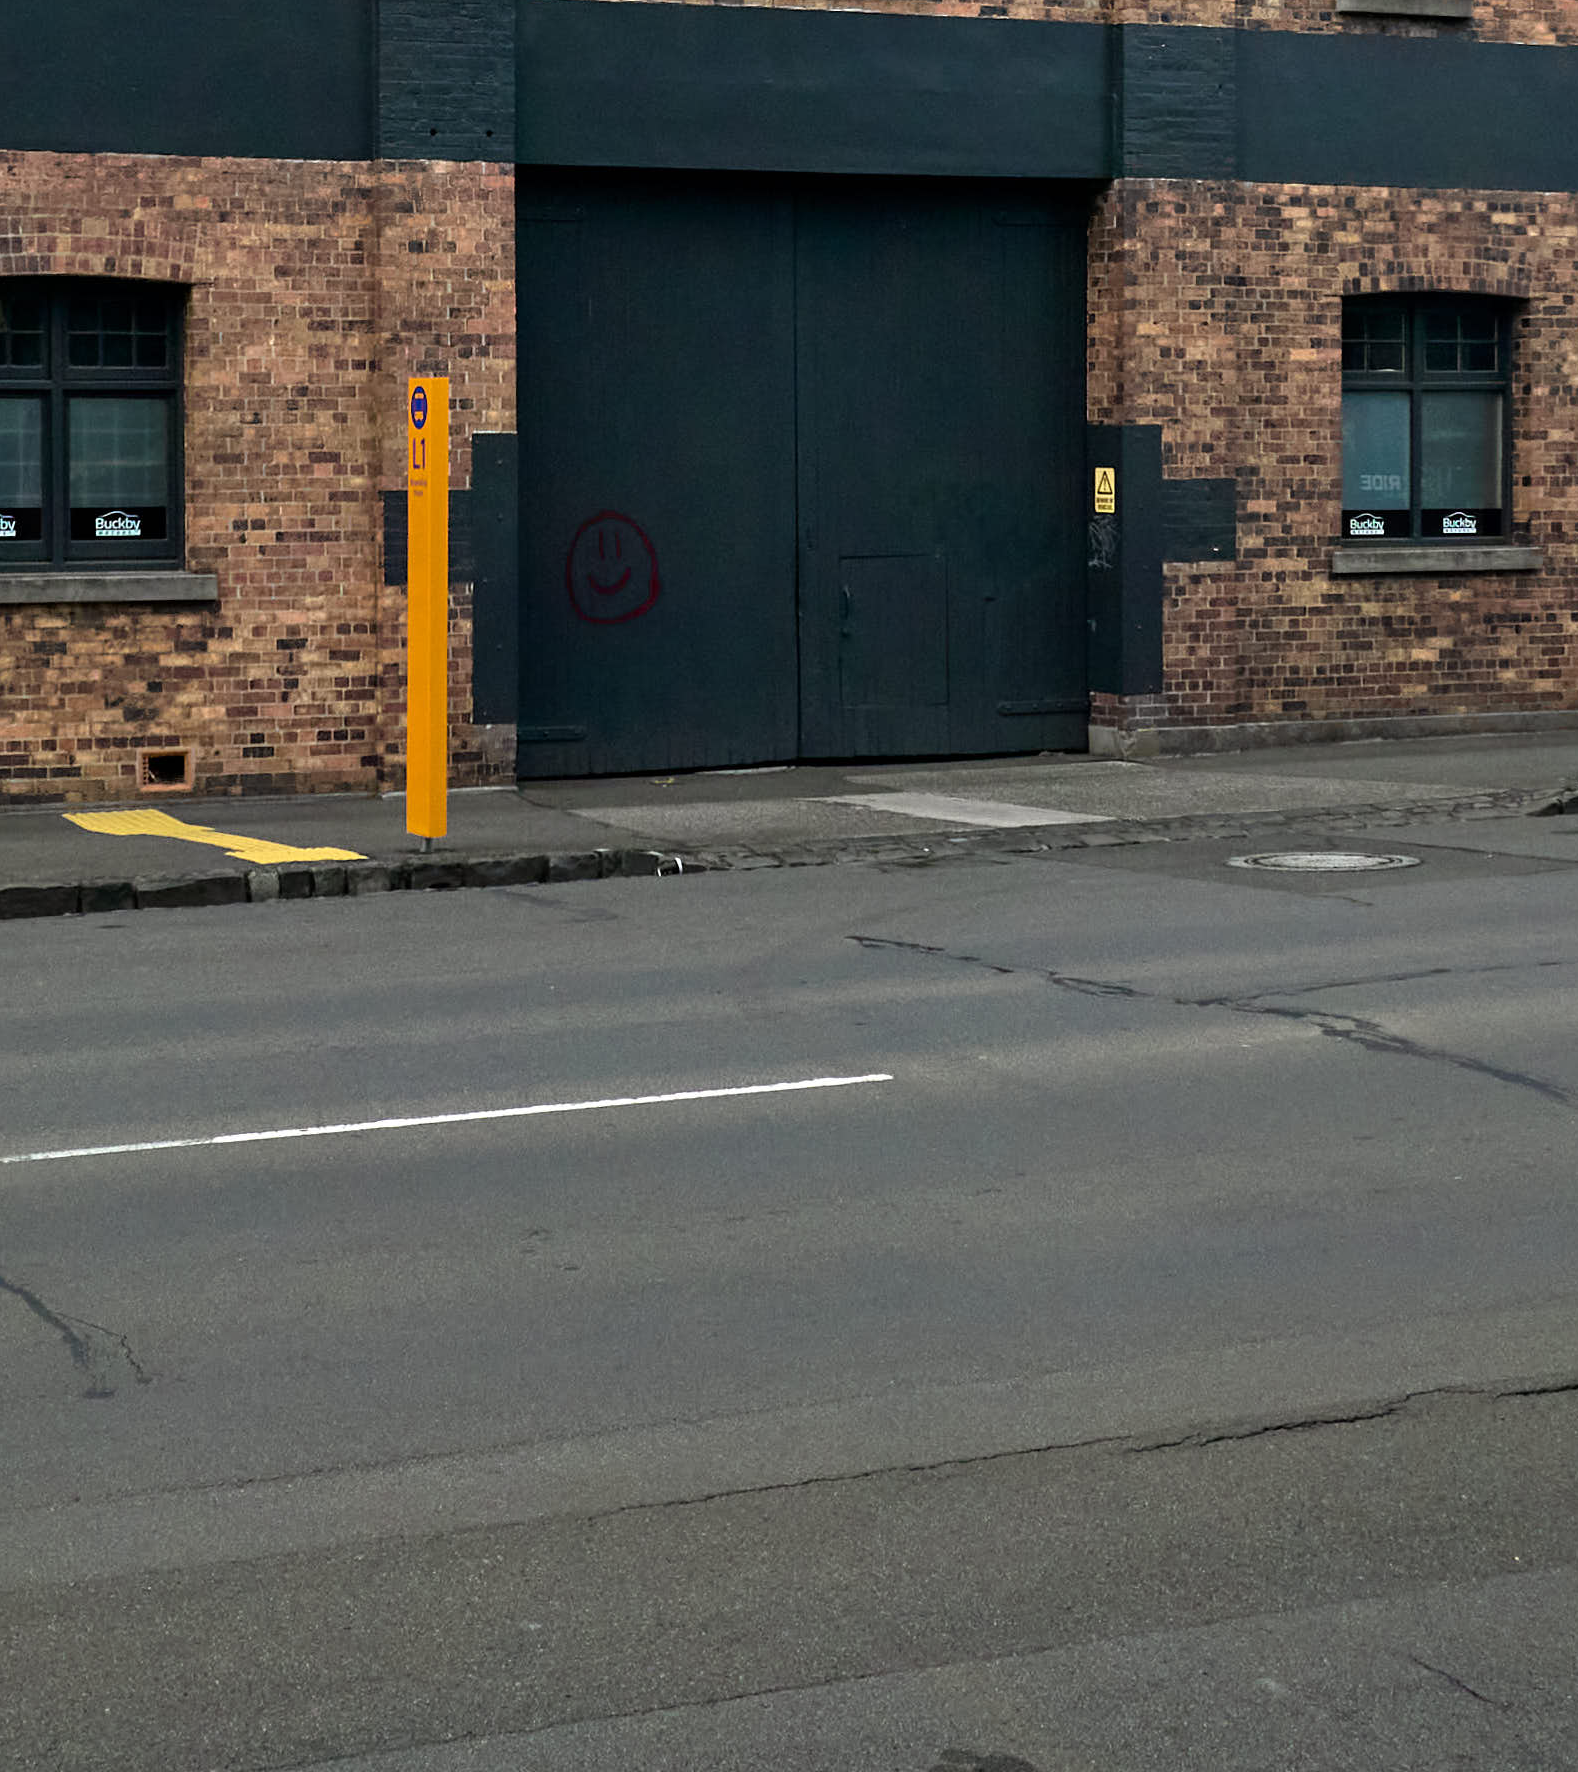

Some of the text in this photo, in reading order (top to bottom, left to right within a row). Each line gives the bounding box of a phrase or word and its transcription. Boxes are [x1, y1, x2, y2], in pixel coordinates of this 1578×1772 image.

[413, 437, 426, 469] L1
[95, 517, 141, 531] Buckby
[1350, 518, 1384, 530] Buckby
[1443, 517, 1476, 528] Buckby
